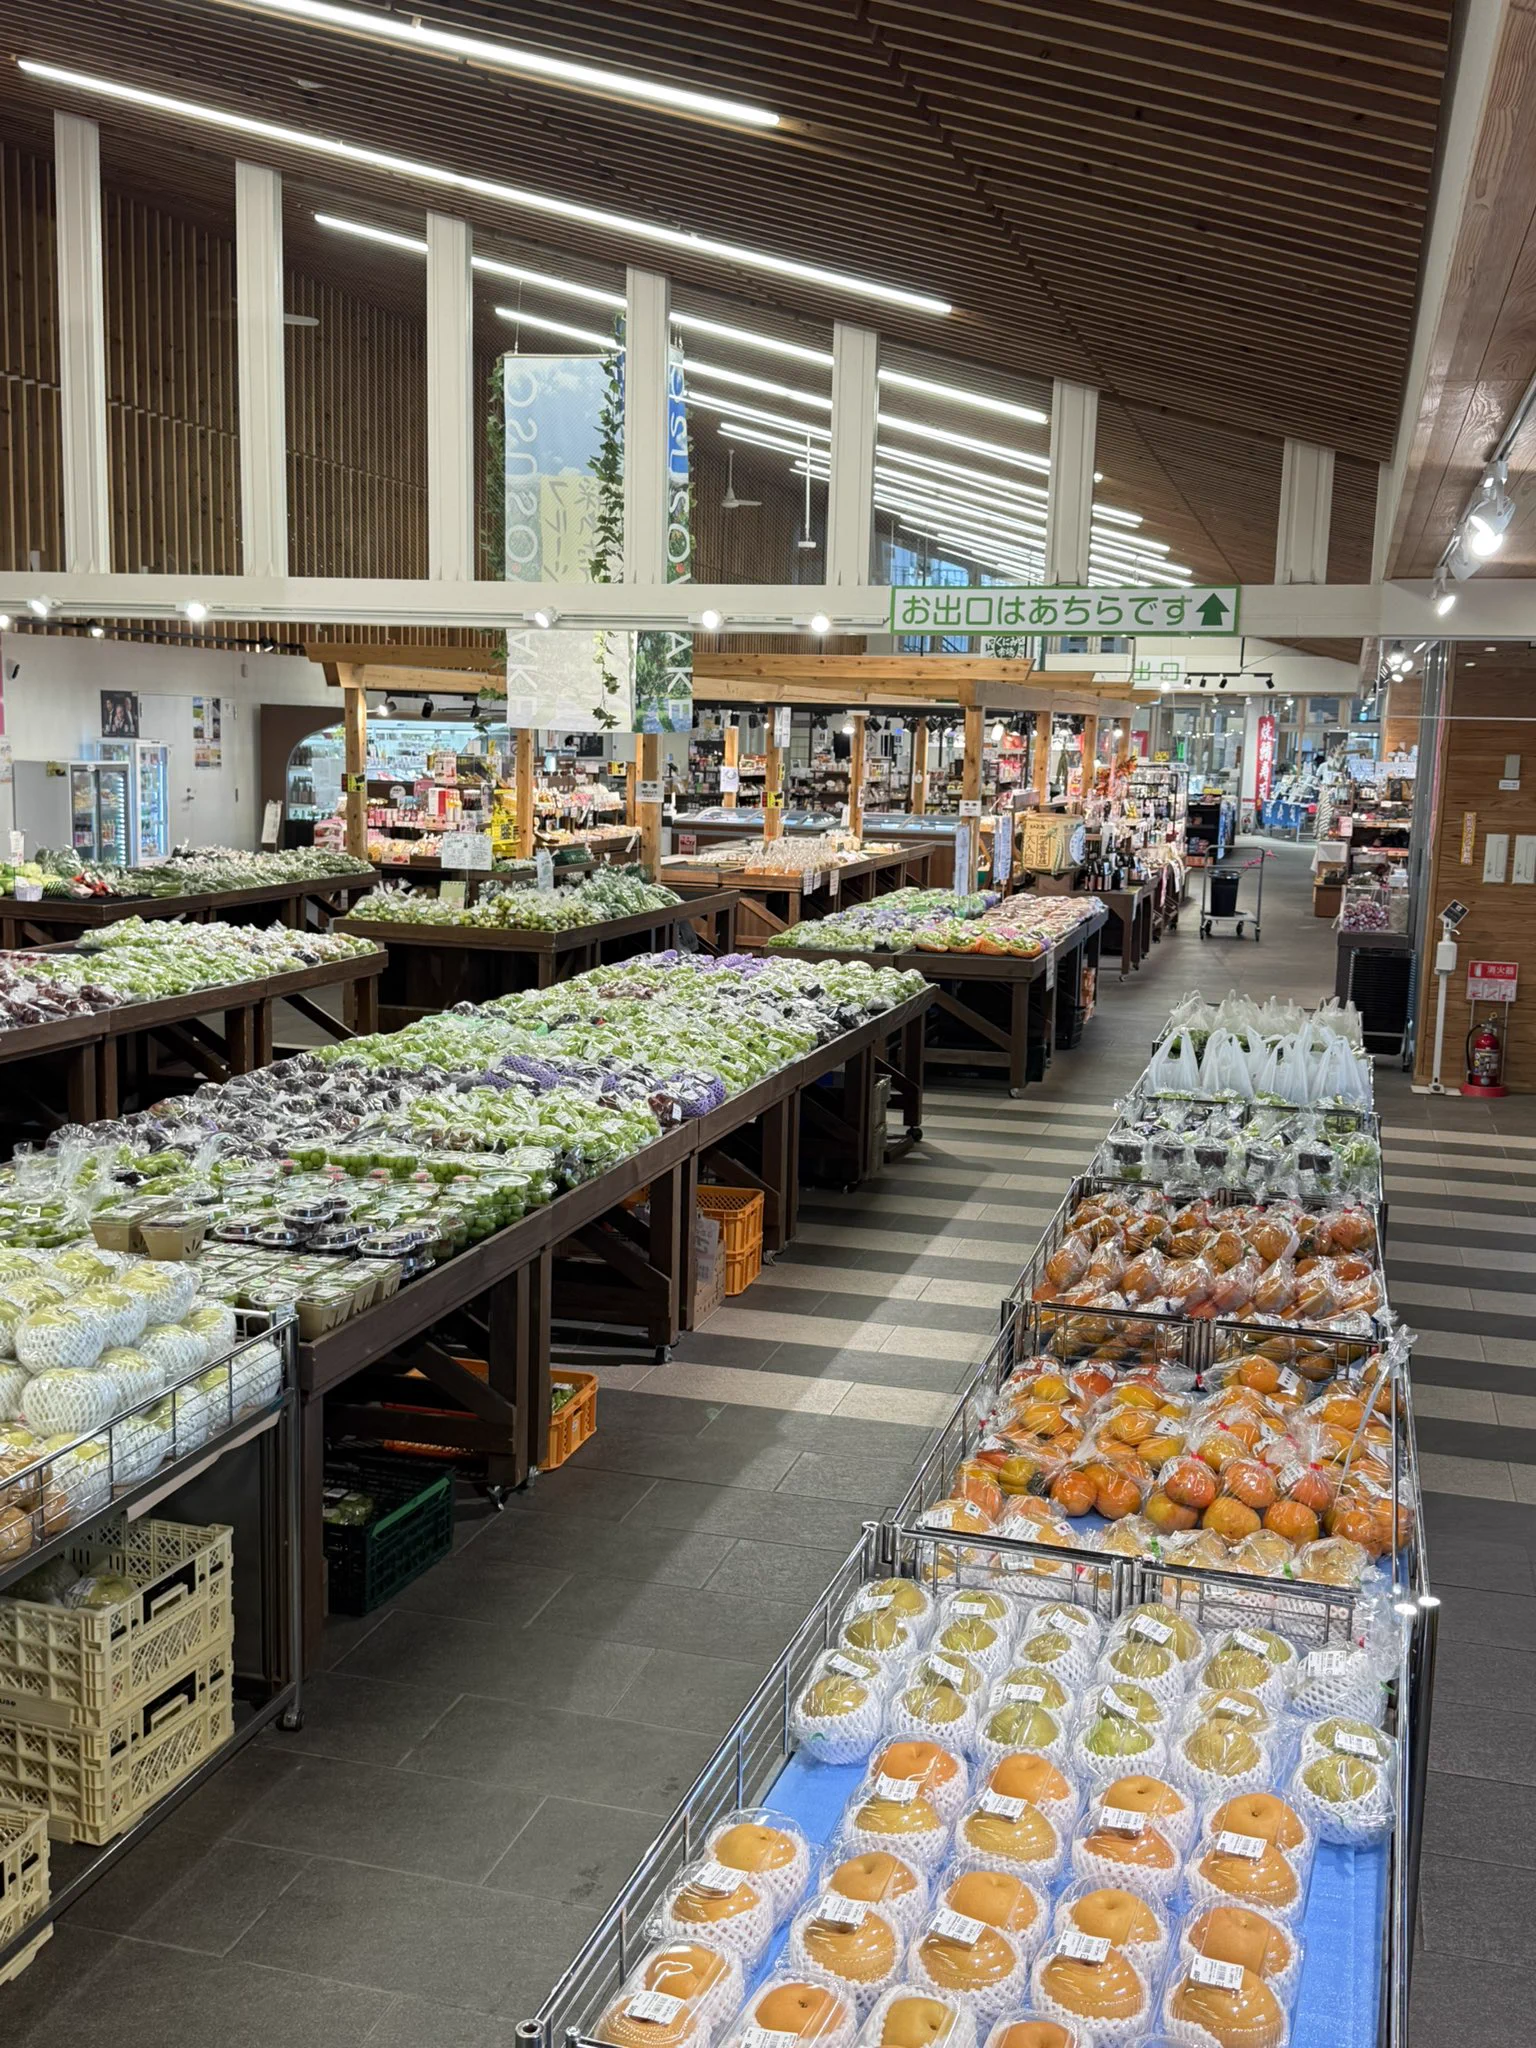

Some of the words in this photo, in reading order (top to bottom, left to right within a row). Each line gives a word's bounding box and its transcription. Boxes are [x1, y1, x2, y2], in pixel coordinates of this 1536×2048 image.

[902, 594, 1193, 626] お出口はあちらです
[1133, 660, 1179, 681] 出口
[1487, 965, 1514, 975] 消火器
